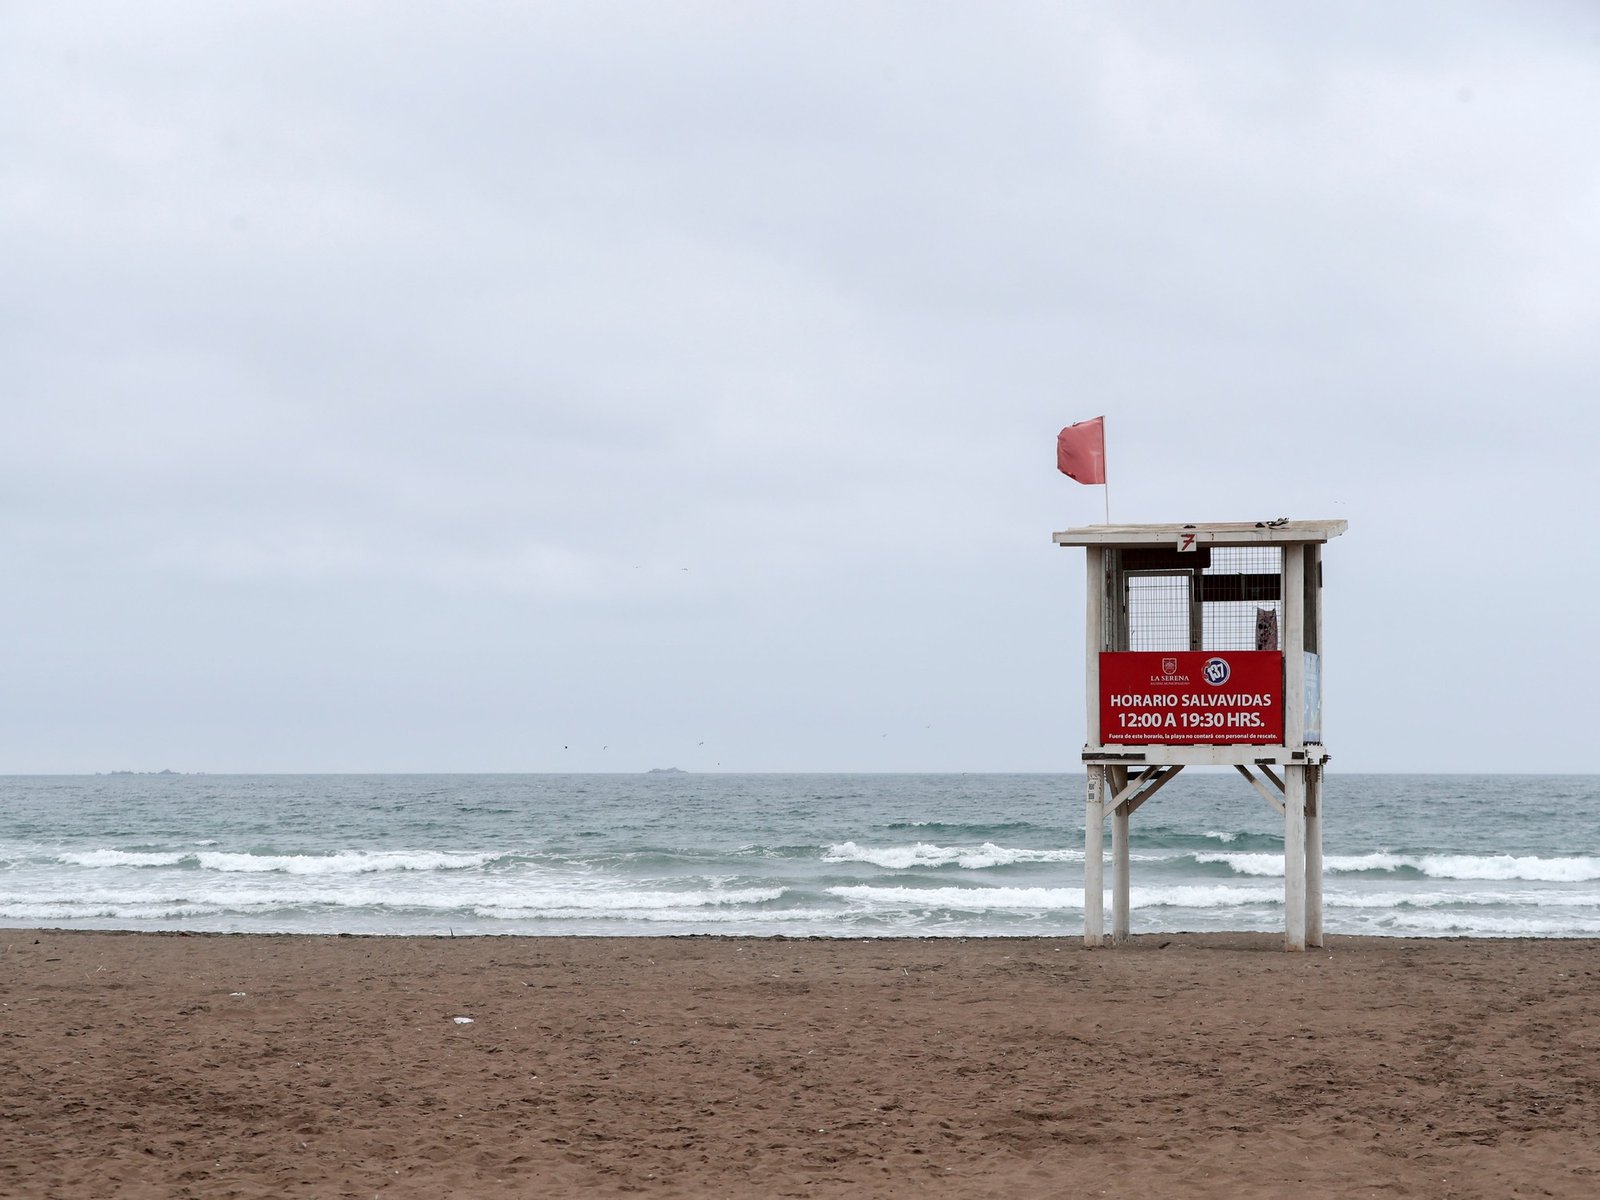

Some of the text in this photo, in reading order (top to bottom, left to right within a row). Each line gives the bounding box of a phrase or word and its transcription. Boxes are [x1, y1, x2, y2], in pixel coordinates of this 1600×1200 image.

[1180, 534, 1196, 551] 7
[1207, 663, 1225, 681] 137
[1110, 694, 1272, 707] HORARIO SALVAVIDAS
[1118, 713, 1265, 727] 12:00 A 19:30 HRS.
